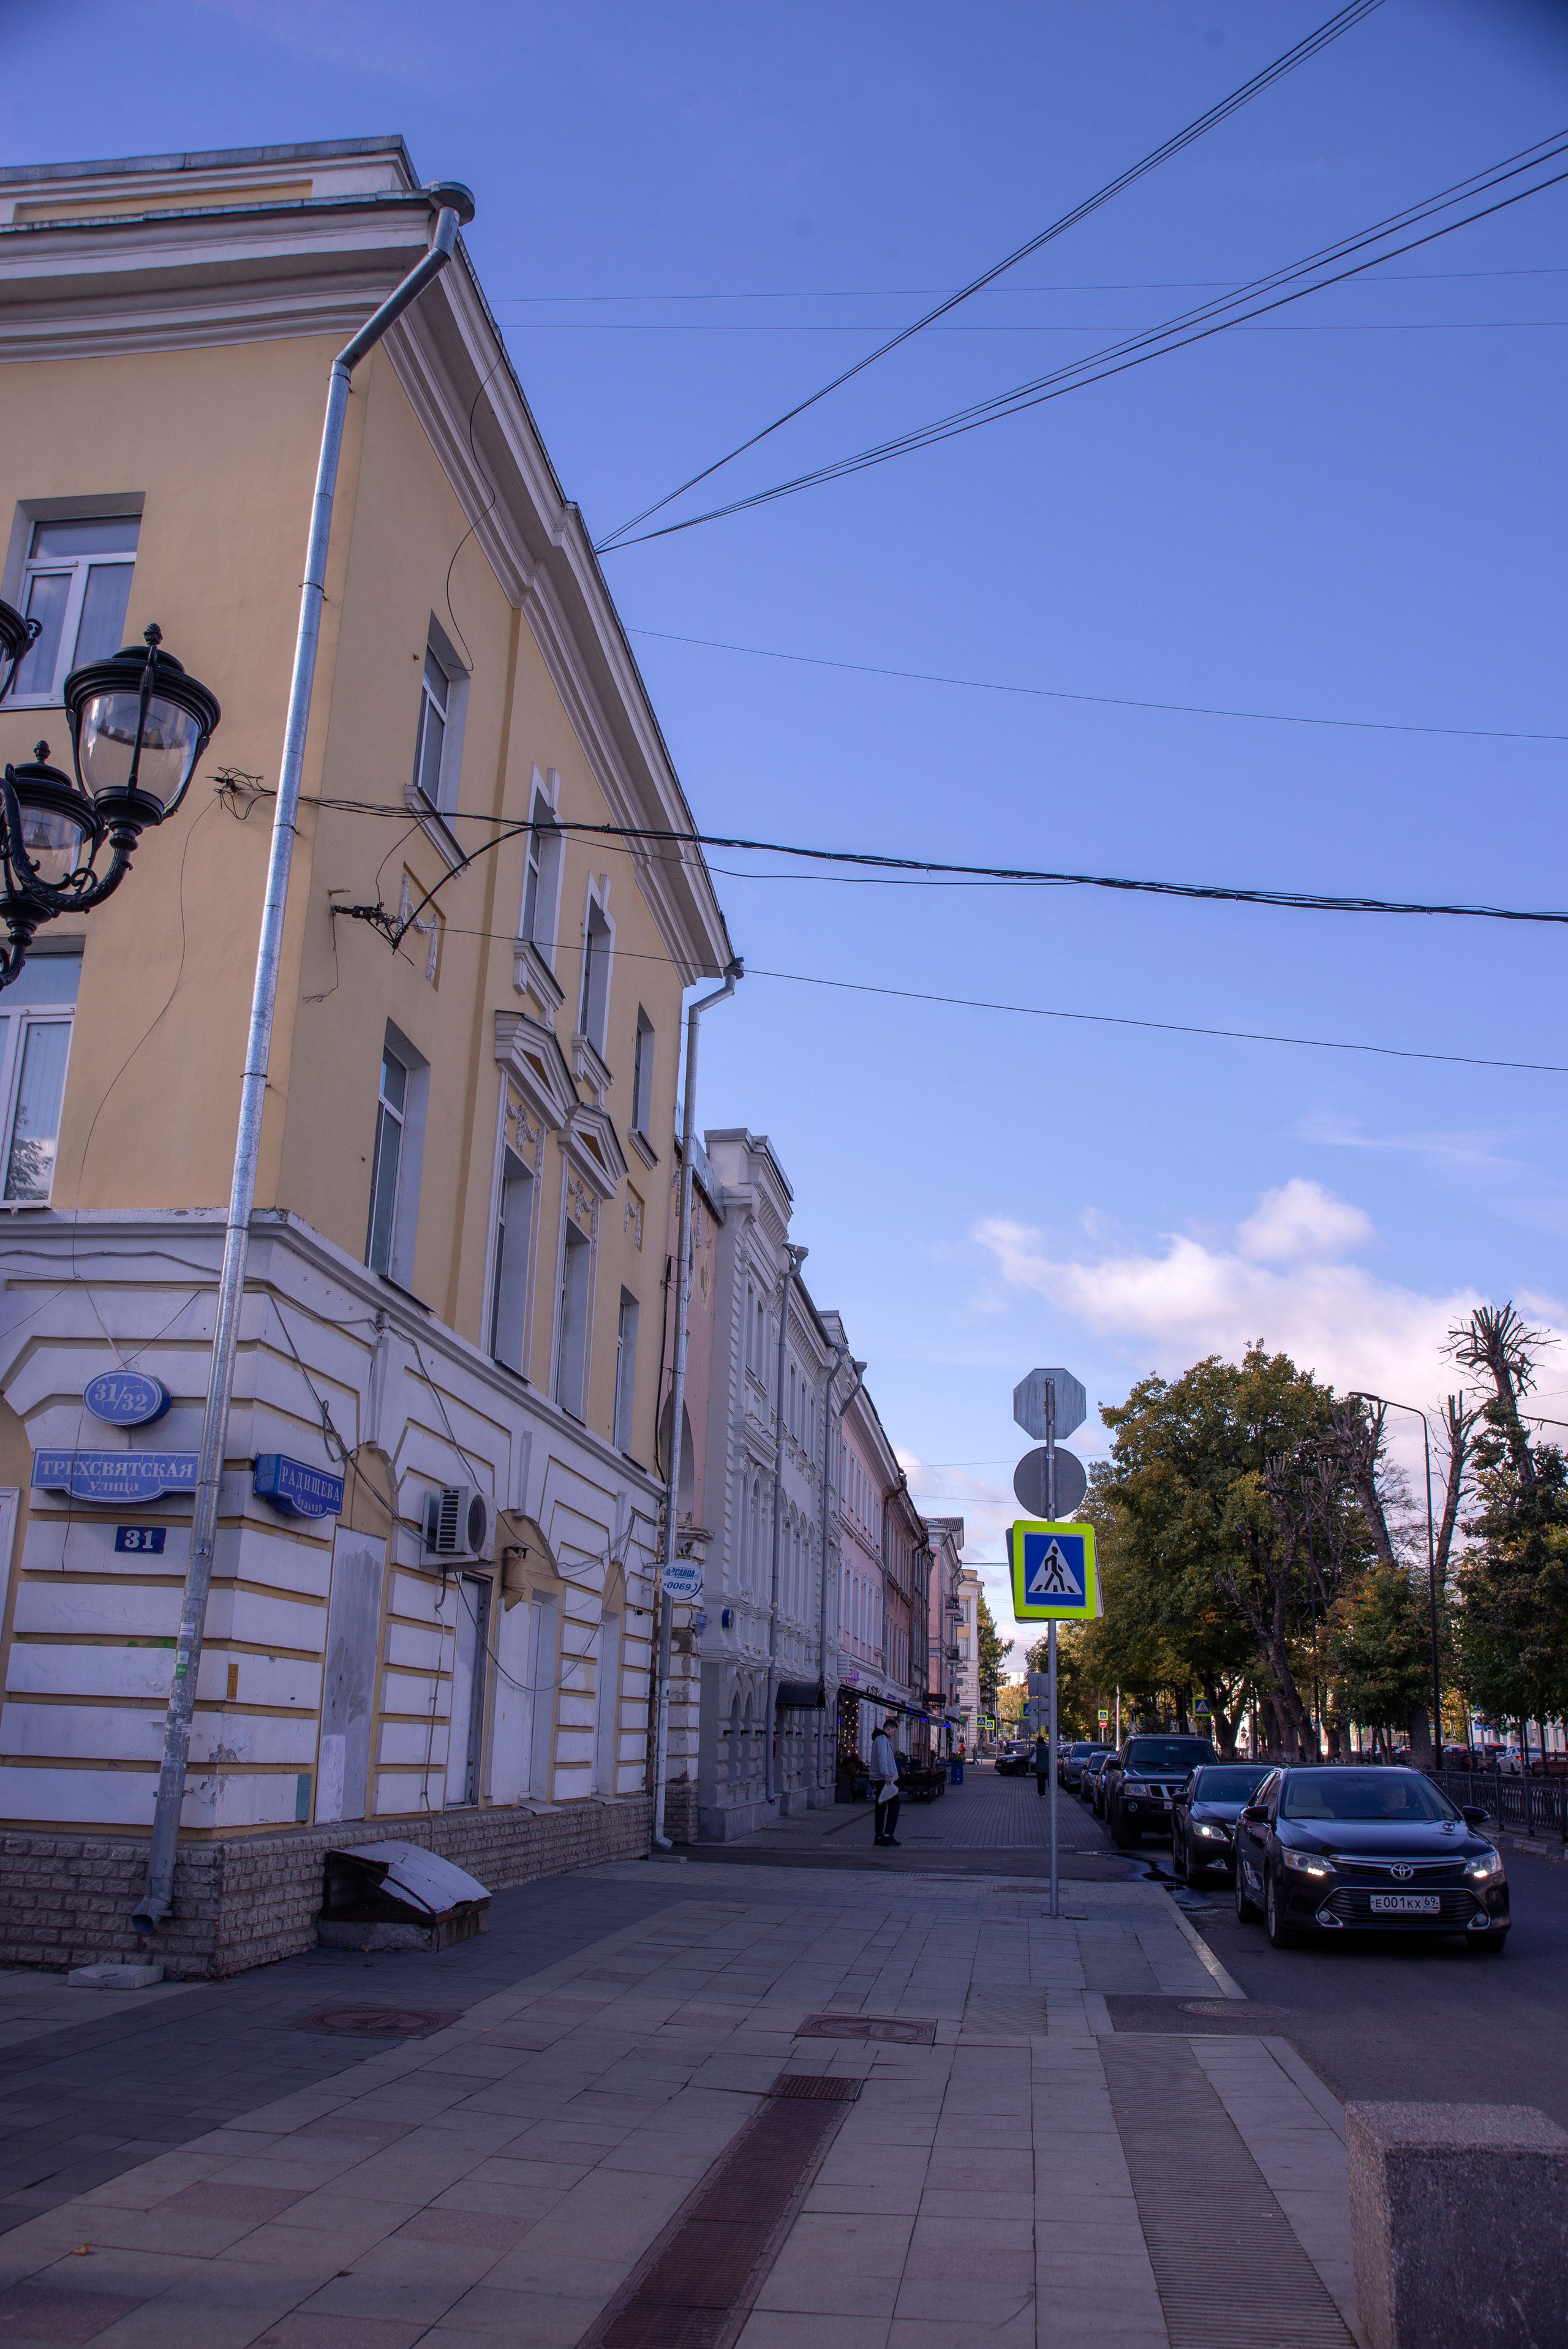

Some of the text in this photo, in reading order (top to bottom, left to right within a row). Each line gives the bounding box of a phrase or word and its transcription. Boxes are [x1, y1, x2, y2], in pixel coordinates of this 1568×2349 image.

[94, 1382, 148, 1412] 31/32
[40, 1460, 193, 1478] ТРЕХСВЯТСКАЯ
[87, 1480, 139, 1493] улица
[282, 1465, 341, 1503] РАДИЩЕВА
[296, 1494, 323, 1514] бульвар
[124, 1529, 154, 1550] 31
[1375, 1896, 1421, 1909] Е001КХ
